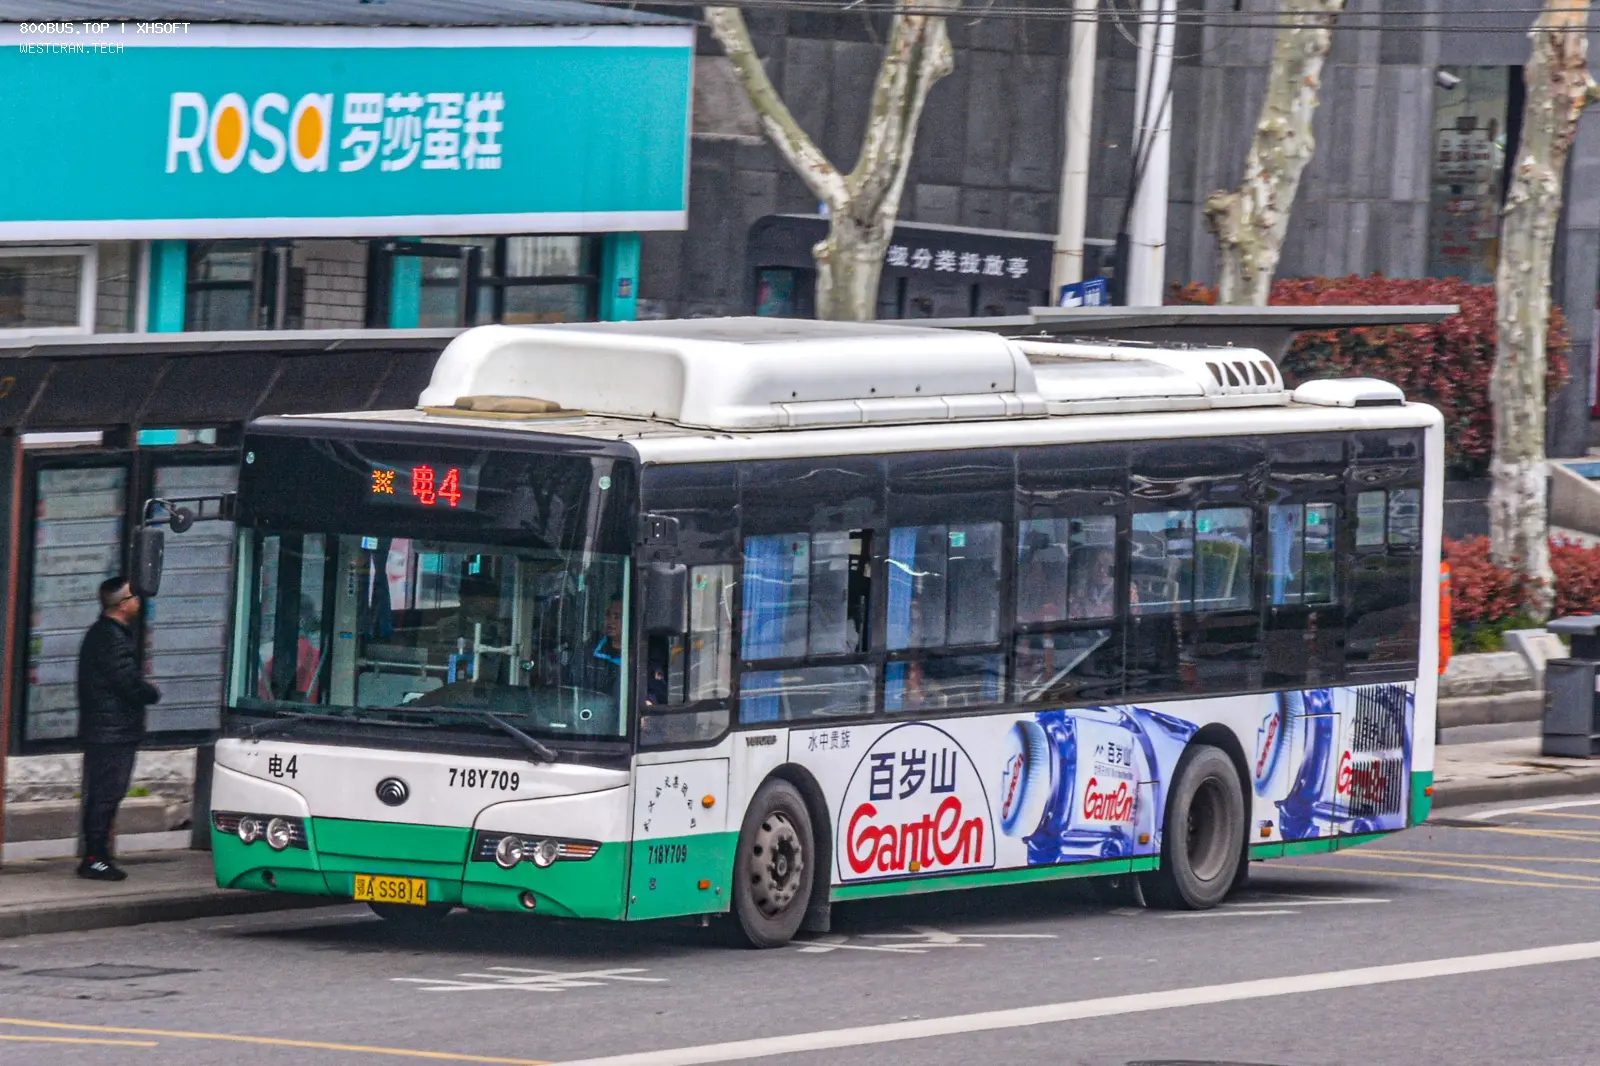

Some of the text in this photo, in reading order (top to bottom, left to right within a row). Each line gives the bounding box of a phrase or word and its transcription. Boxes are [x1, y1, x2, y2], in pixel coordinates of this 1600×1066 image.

[339, 91, 505, 172] 罗莎蛋糕
[412, 464, 462, 509] 电4
[808, 730, 850, 751] 水中贵族
[1108, 742, 1132, 767] 百岁山
[269, 753, 298, 779] 电4
[448, 767, 520, 791] 718Y709
[869, 748, 957, 801] 百岁山
[1083, 777, 1133, 821] Ganten
[847, 796, 984, 874] Ganten
[648, 844, 688, 865] 718Y709
